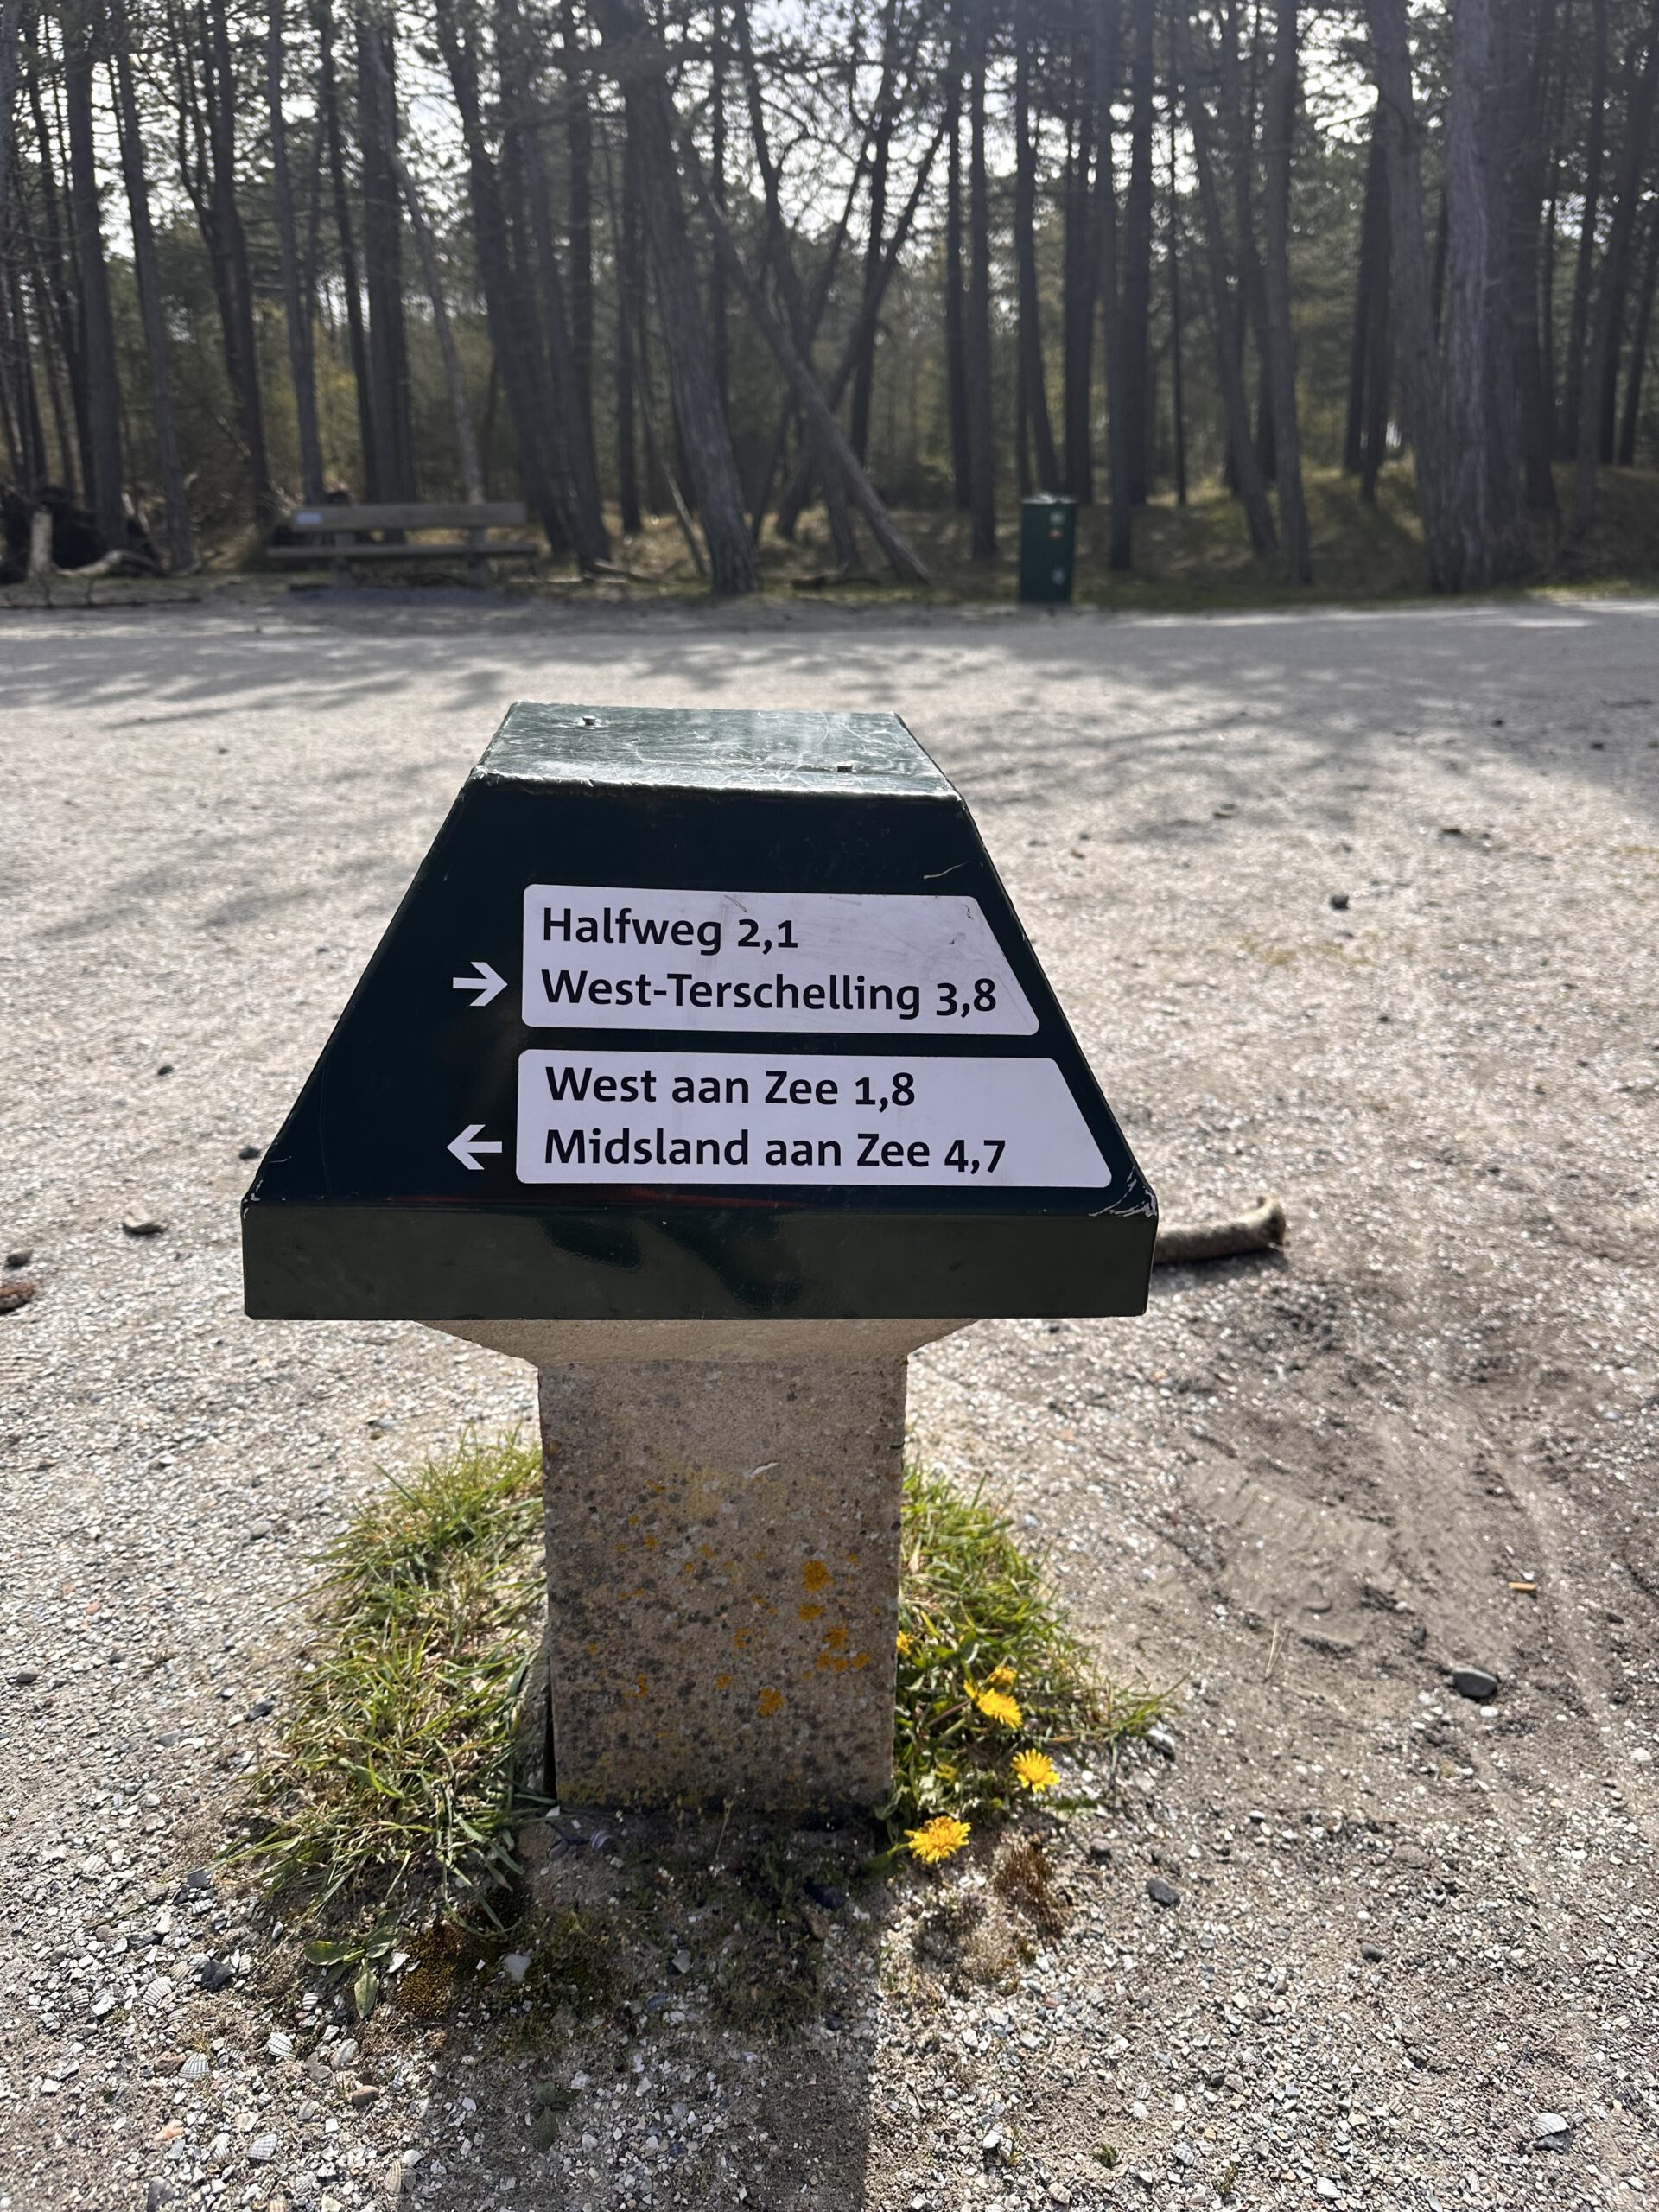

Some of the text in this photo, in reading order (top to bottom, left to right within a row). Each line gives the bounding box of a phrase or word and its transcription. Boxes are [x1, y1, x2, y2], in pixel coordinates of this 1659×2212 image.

[543, 907, 798, 957] Halfweg 2,1
[541, 969, 996, 1019] West-Terschelling 3,8
[545, 1066, 915, 1113] West aan Zee 1,8
[544, 1127, 1006, 1175] Midsland aan Zee 4,7
